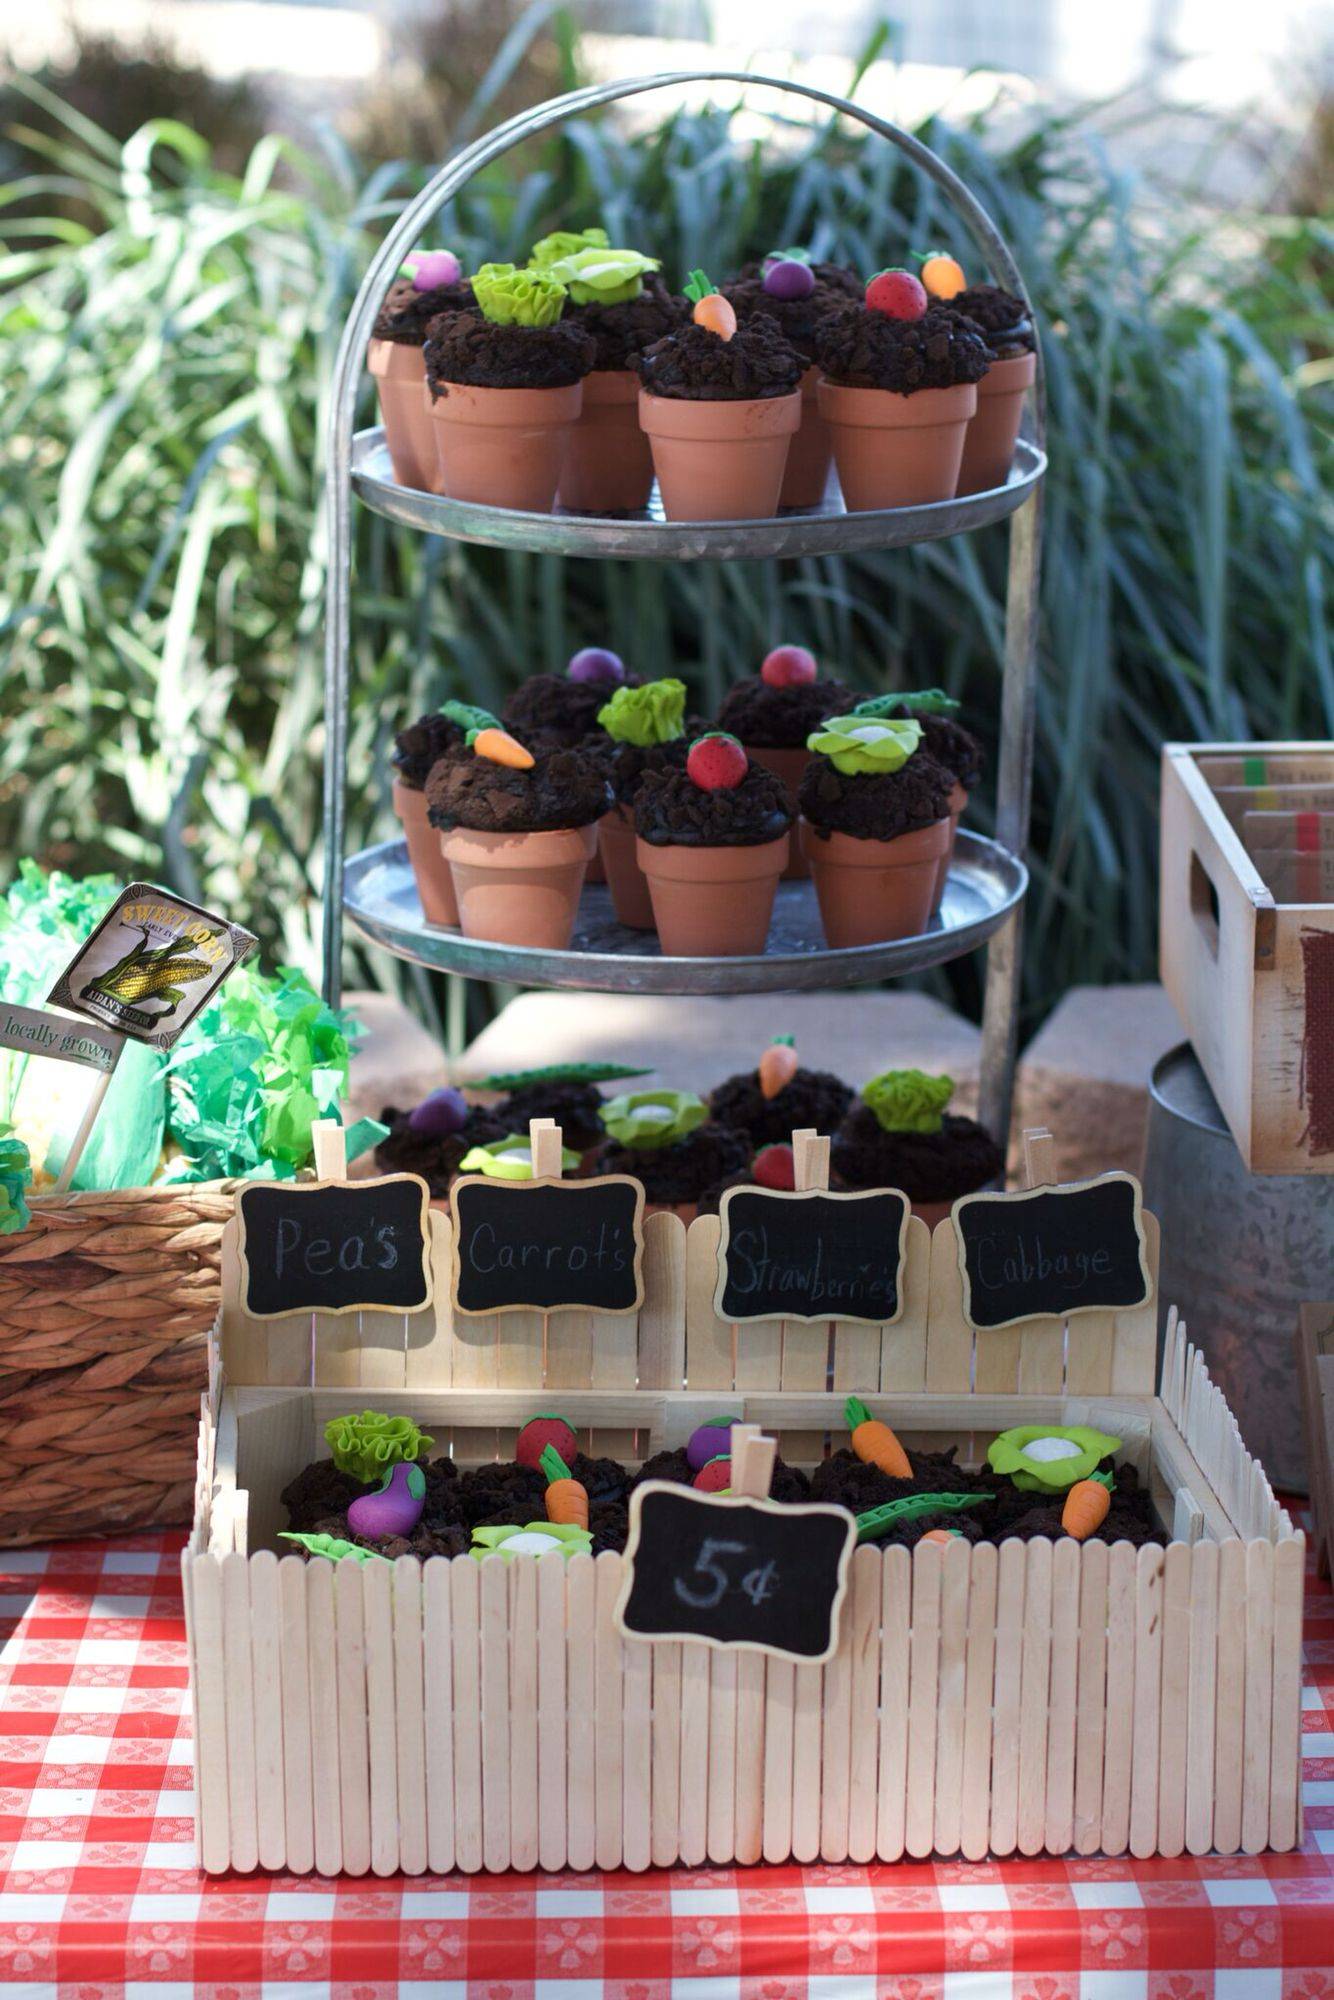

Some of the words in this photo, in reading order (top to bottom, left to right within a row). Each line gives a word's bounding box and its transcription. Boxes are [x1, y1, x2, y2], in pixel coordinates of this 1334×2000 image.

[122, 904, 190, 928] SWEET
[185, 921, 229, 963] CORN
[87, 989, 122, 1014] AIDAN'S
[4, 1016, 58, 1048] locally
[59, 1033, 112, 1061] grown
[274, 1217, 398, 1280] Pea's
[469, 1221, 627, 1273] Carrot's
[977, 1232, 1113, 1290] Cabbage
[674, 1537, 778, 1608] 5¢
